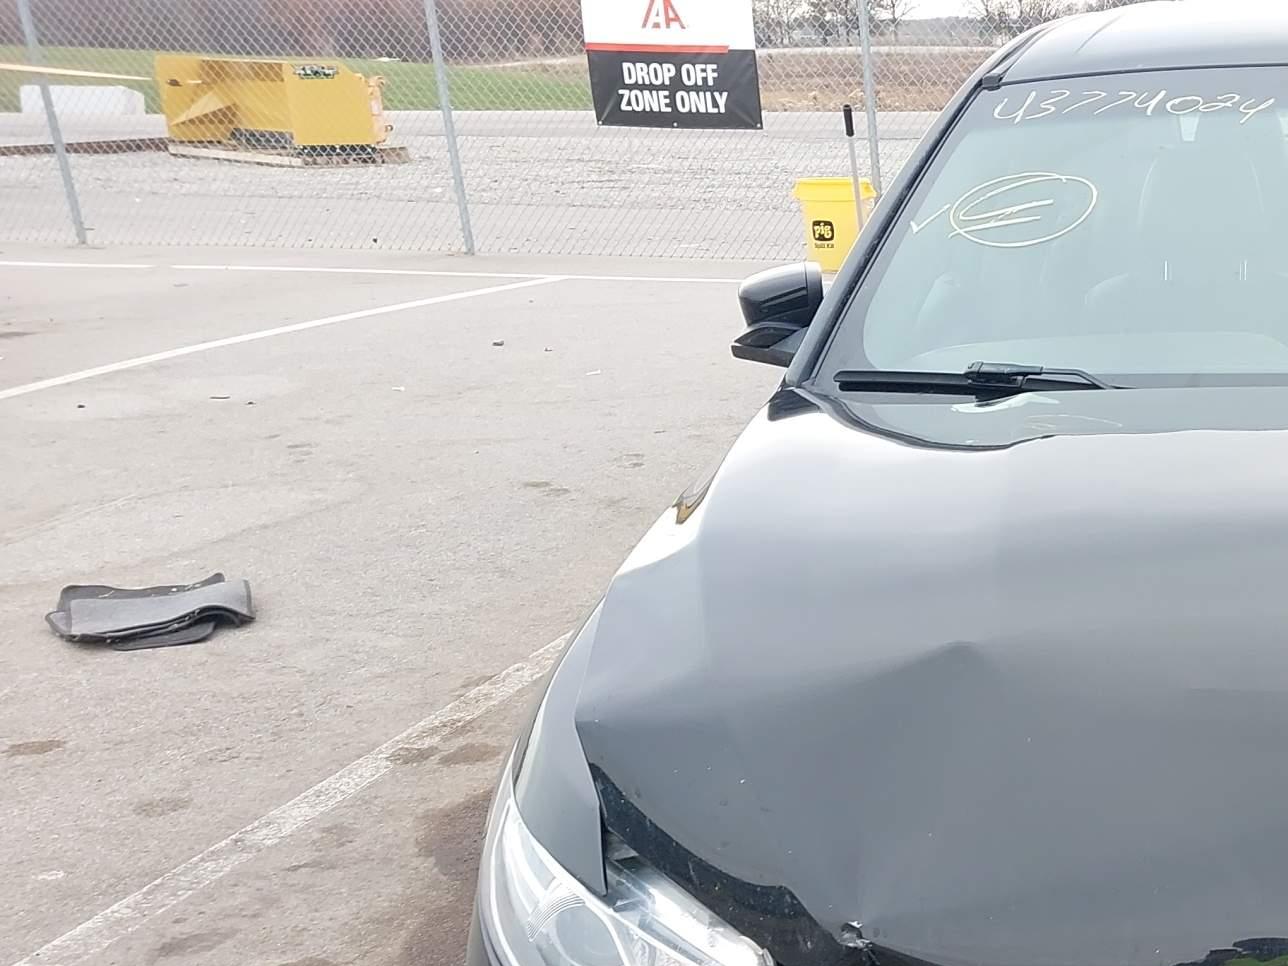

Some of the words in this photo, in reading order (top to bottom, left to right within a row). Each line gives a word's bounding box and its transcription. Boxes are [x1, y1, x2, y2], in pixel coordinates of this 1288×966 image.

[622, 62, 676, 86] DROP
[681, 63, 719, 87] OFF
[618, 89, 672, 113] ZONE
[675, 90, 728, 114] ONLY
[993, 89, 1276, 125] 43774024
